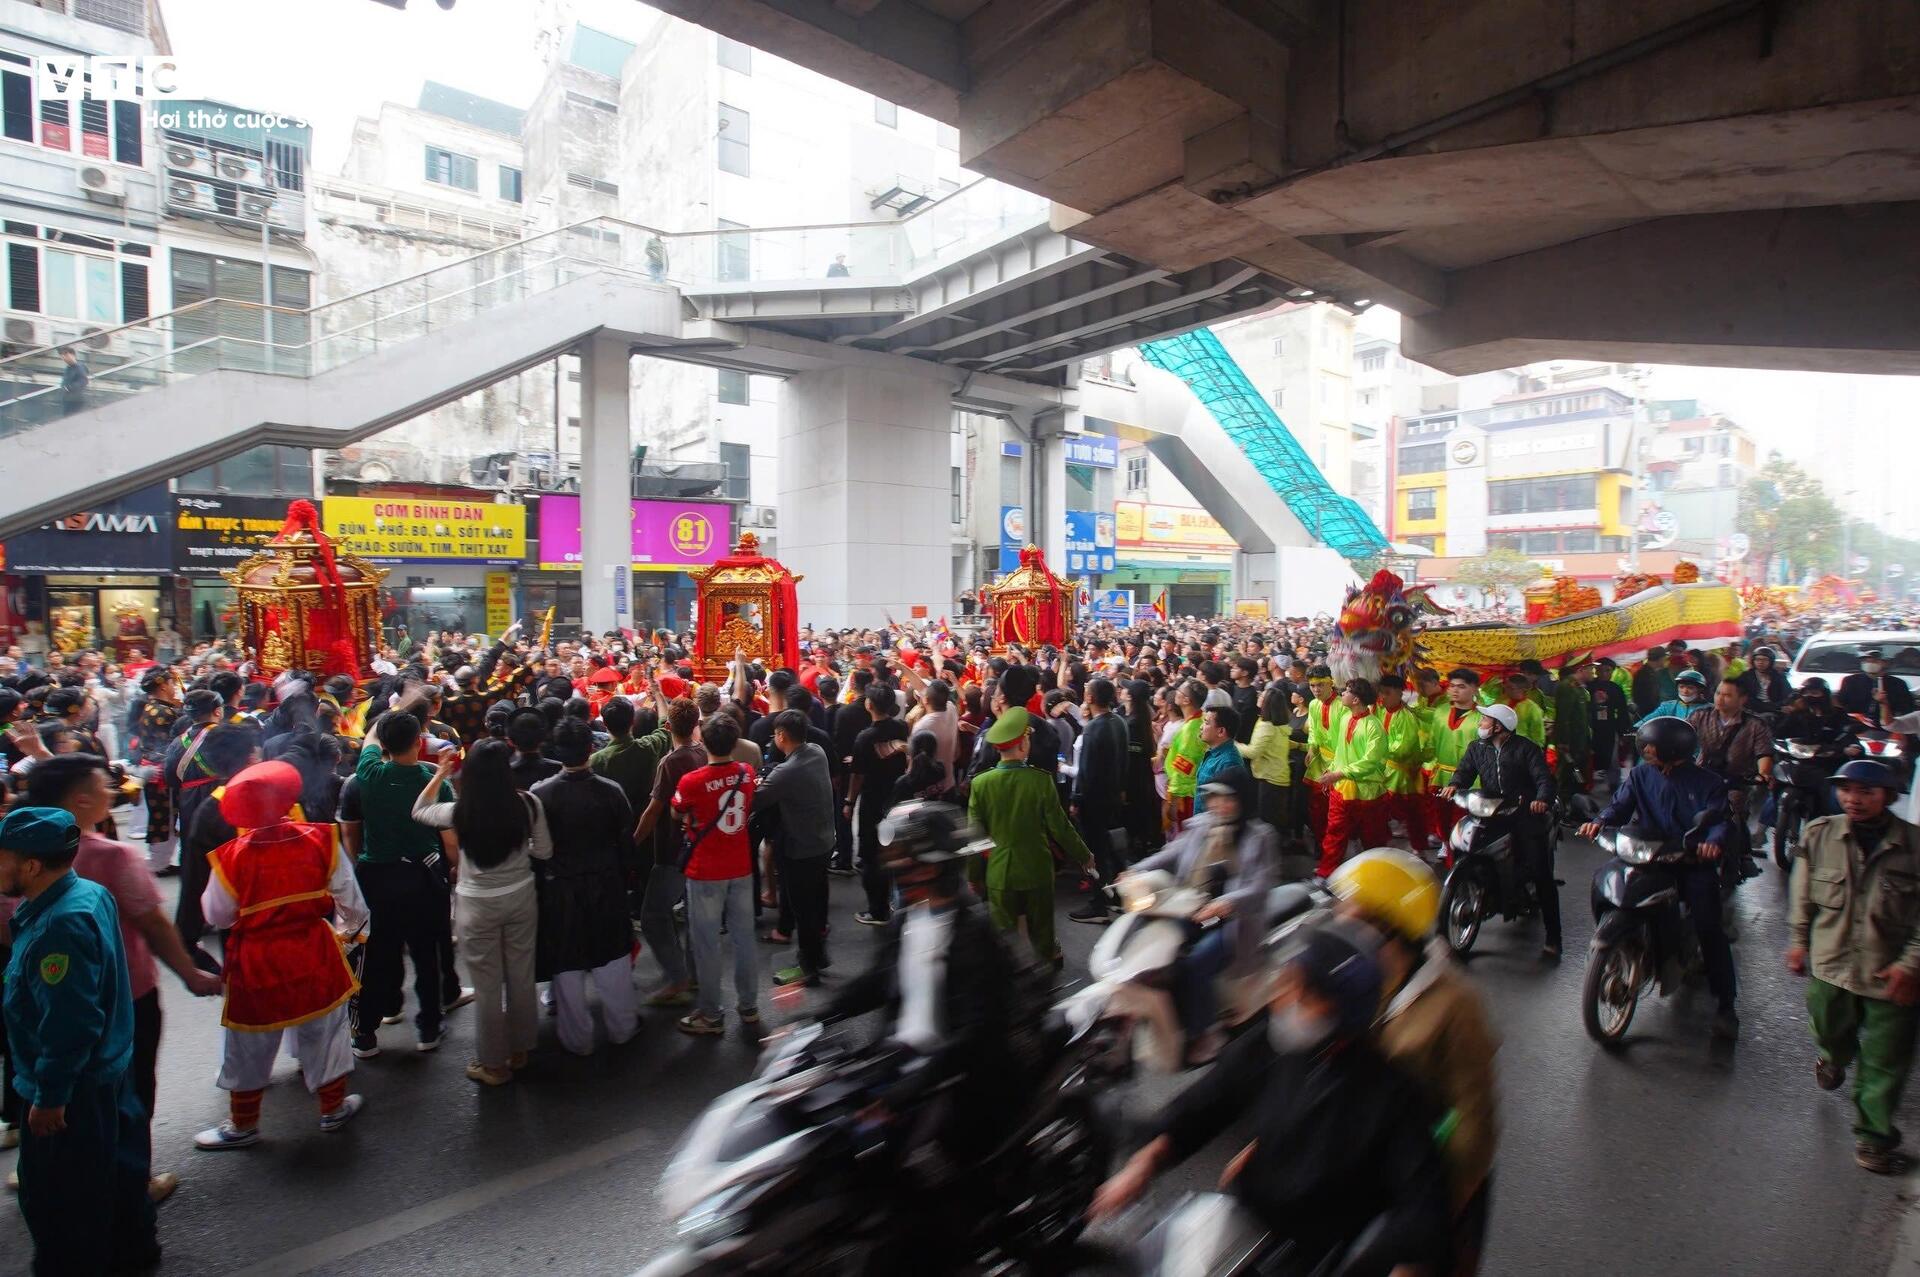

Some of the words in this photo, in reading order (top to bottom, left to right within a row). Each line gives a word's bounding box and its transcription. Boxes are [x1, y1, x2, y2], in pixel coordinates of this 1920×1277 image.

[374, 503, 409, 518] CƠM
[677, 518, 707, 542] 81
[705, 779, 724, 792] KIM
[717, 790, 745, 834] 8
